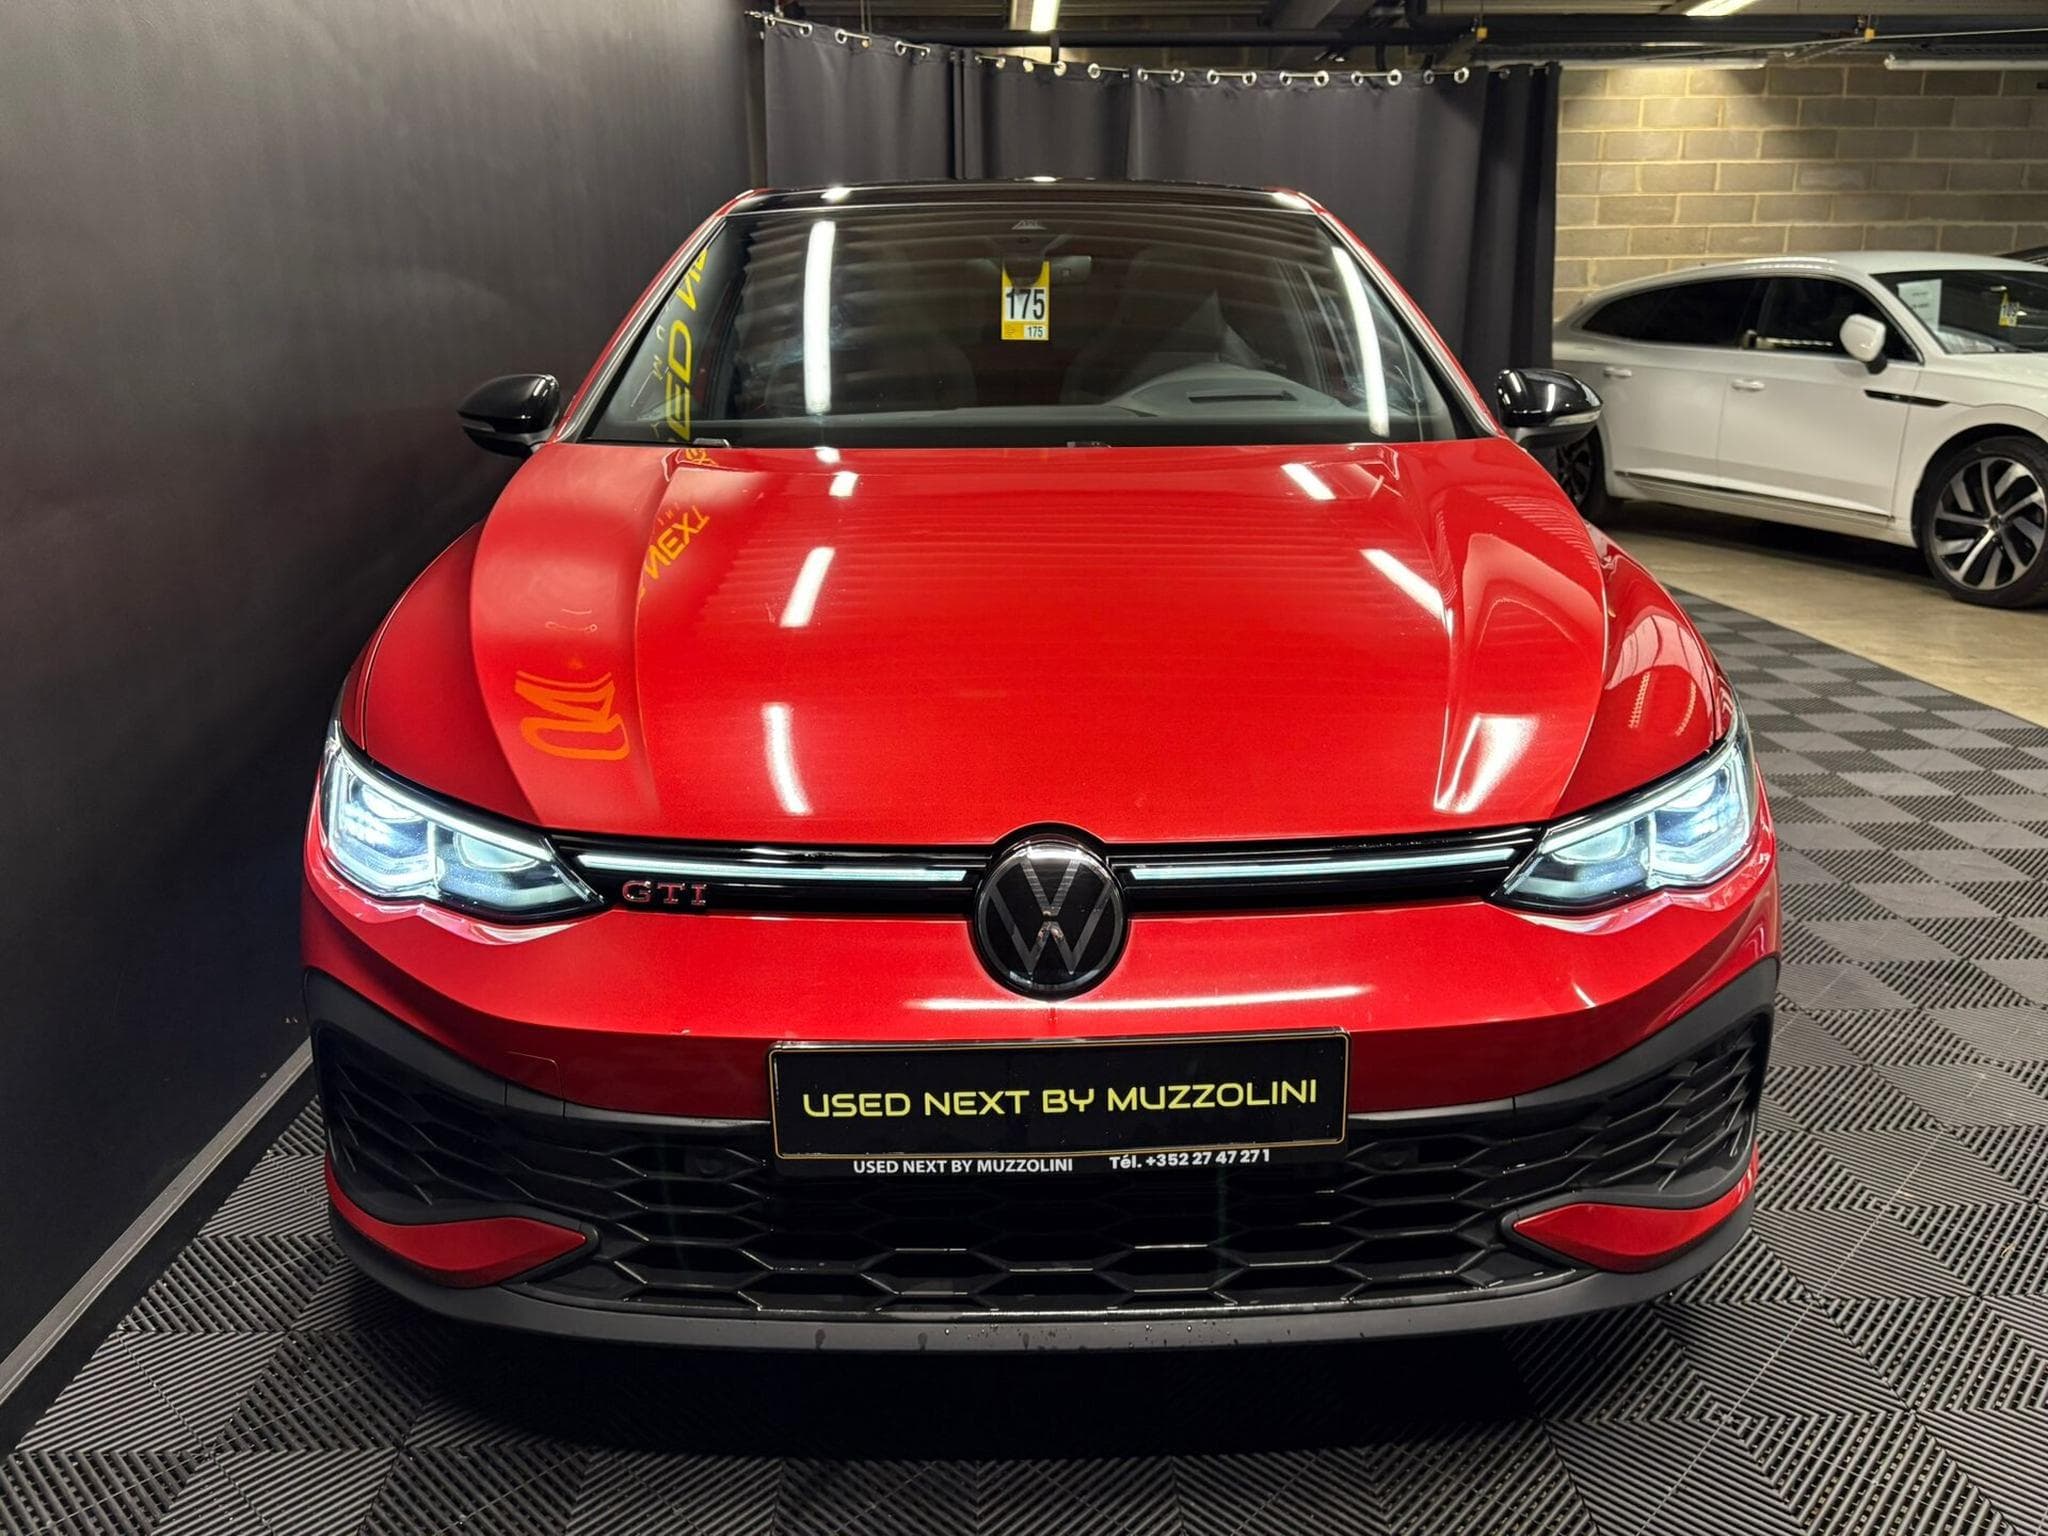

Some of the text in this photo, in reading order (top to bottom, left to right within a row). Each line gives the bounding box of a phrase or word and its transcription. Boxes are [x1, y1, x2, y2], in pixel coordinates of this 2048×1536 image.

[1006, 288, 1045, 320] 175
[1028, 326, 1043, 338] 175
[622, 880, 707, 905] GTI
[803, 1079, 1317, 1118] USED NEXT BY MUZZOLINI
[853, 1158, 1073, 1174] USED NEXT BY MUZZOLINI
[1109, 1154, 1142, 1169] Tél.
[1146, 1152, 1189, 1167] +352
[1192, 1151, 1212, 1165] 27
[1215, 1150, 1237, 1164] 47
